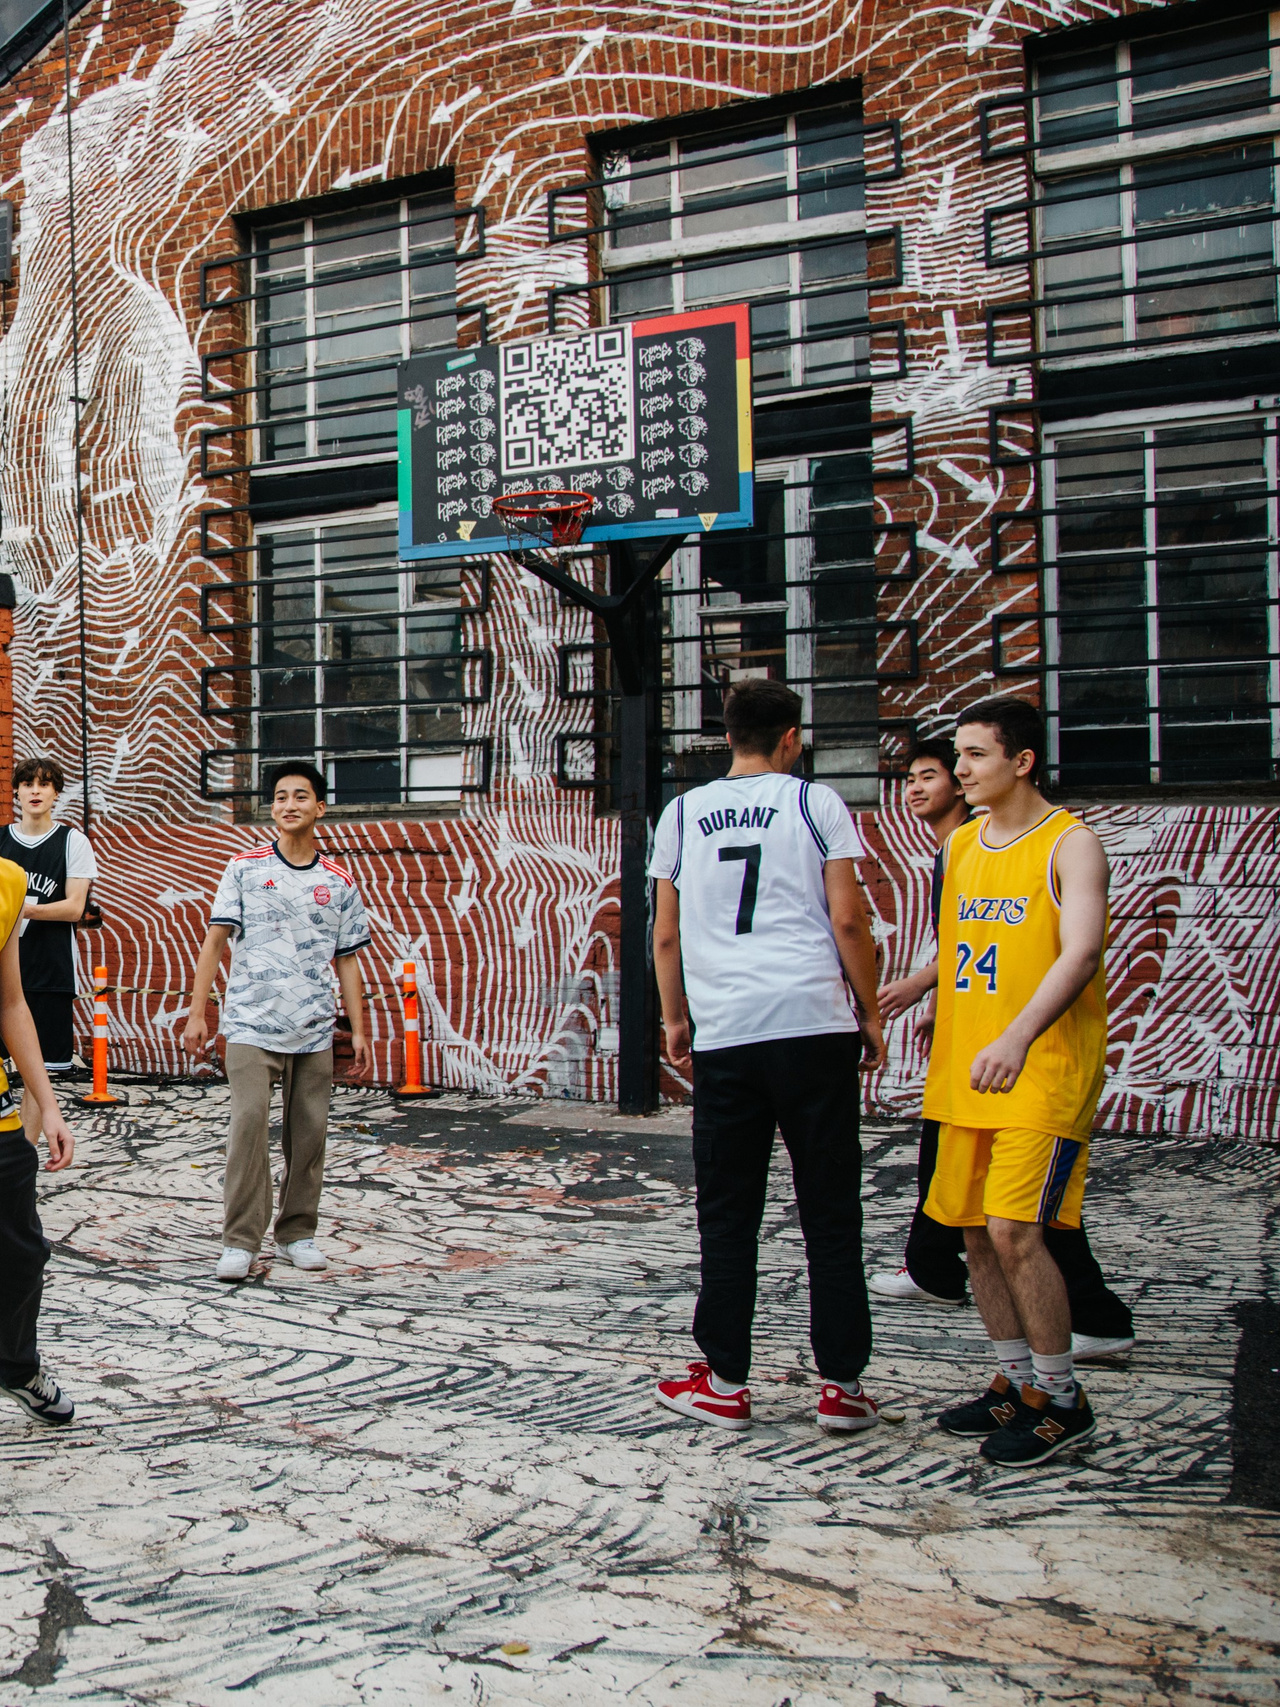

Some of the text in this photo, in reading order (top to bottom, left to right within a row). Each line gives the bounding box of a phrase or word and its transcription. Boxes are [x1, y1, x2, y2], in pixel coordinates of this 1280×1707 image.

[697, 806, 780, 837] DURANT
[717, 843, 762, 936] 7
[955, 942, 999, 995] 24
